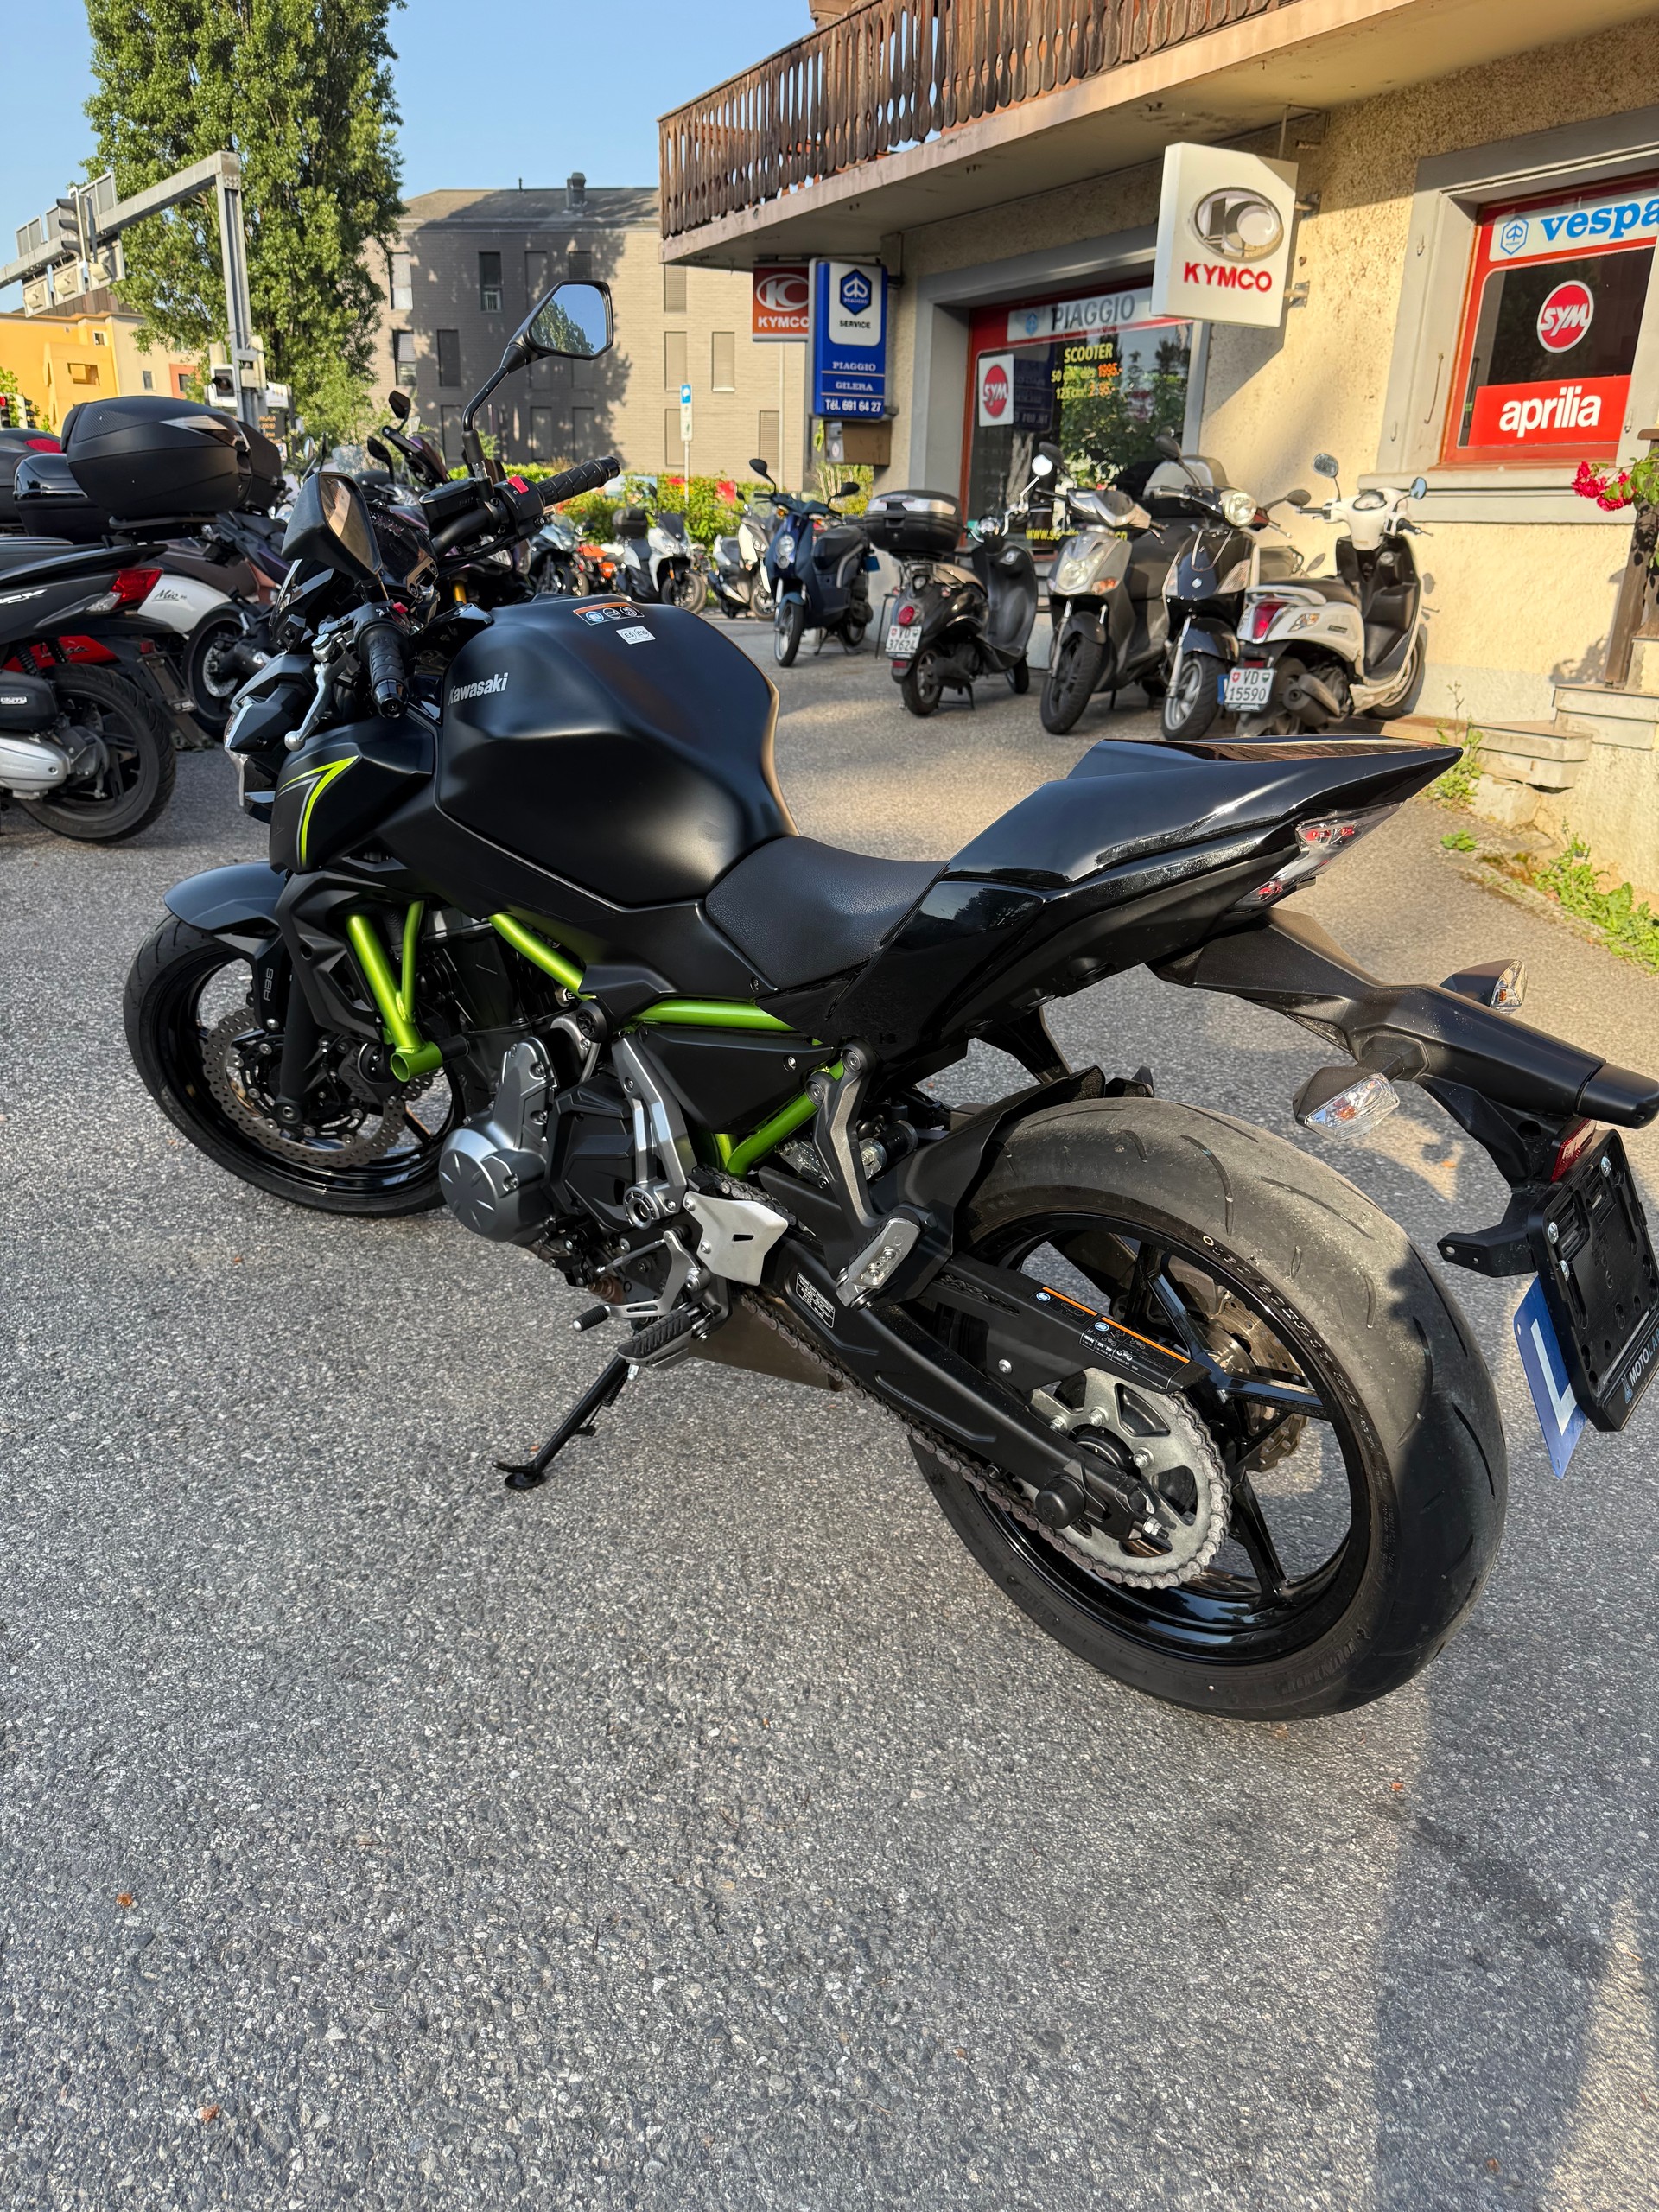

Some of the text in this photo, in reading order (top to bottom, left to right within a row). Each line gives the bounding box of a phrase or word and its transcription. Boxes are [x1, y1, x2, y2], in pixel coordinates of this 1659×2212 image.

[1541, 196, 1659, 242] vespa
[1184, 262, 1273, 293] KYMCO
[758, 316, 810, 328] KYMCO
[1052, 294, 1135, 332] PIAGGIO
[1540, 303, 1590, 337] SYM
[840, 321, 871, 329] SERVICE
[1064, 342, 1113, 364] SCOOTER
[832, 361, 876, 372] PIAGGIO
[1051, 369, 1062, 383] 50
[835, 381, 873, 391] GILERA
[983, 382, 1009, 407] SYM
[825, 398, 881, 413] Tél. 691 64 27
[1499, 385, 1602, 438] aprilia
[888, 639, 917, 652] 37624
[1243, 671, 1259, 684] VD
[448, 672, 509, 706] Kawasaki
[1228, 687, 1267, 702] 15590
[264, 967, 274, 1001] ABS
[1530, 1318, 1578, 1436] L
